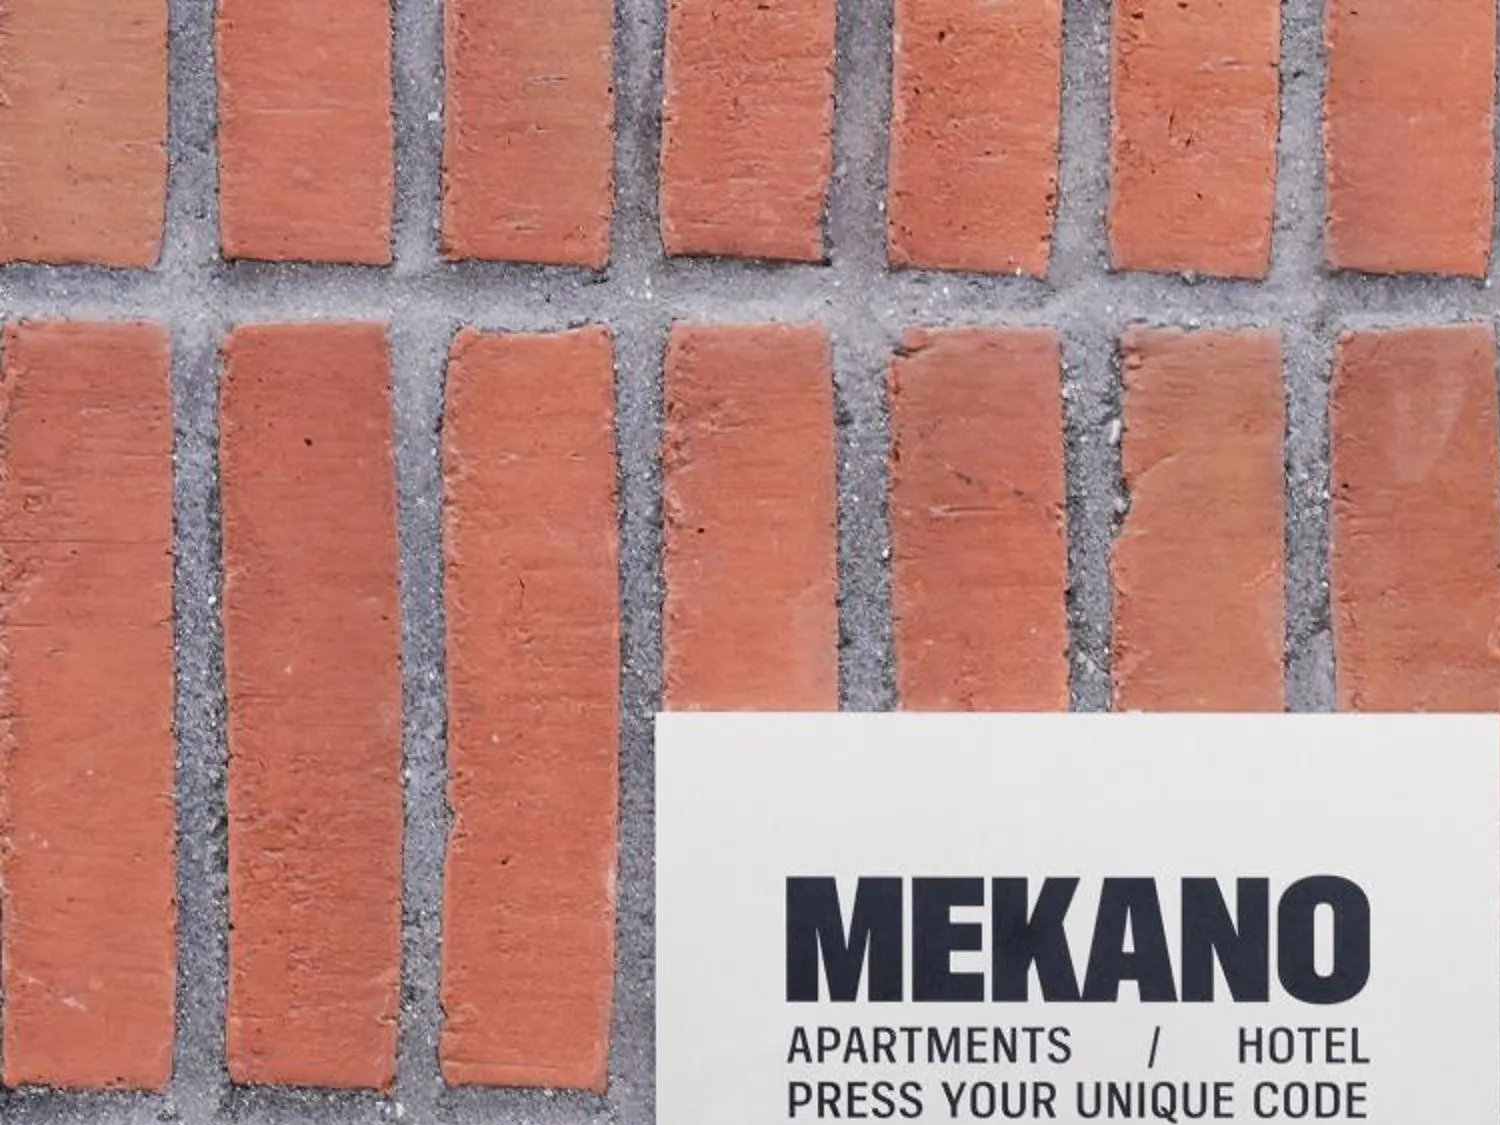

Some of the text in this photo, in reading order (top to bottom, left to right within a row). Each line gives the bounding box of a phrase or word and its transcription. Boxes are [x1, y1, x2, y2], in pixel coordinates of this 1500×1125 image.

[786, 875, 1370, 1005] MEKANO
[787, 1026, 1370, 1068] APARTMENTS / HOTEL
[788, 1081, 1368, 1124] PRESS YOUR UNIQUE CODE
